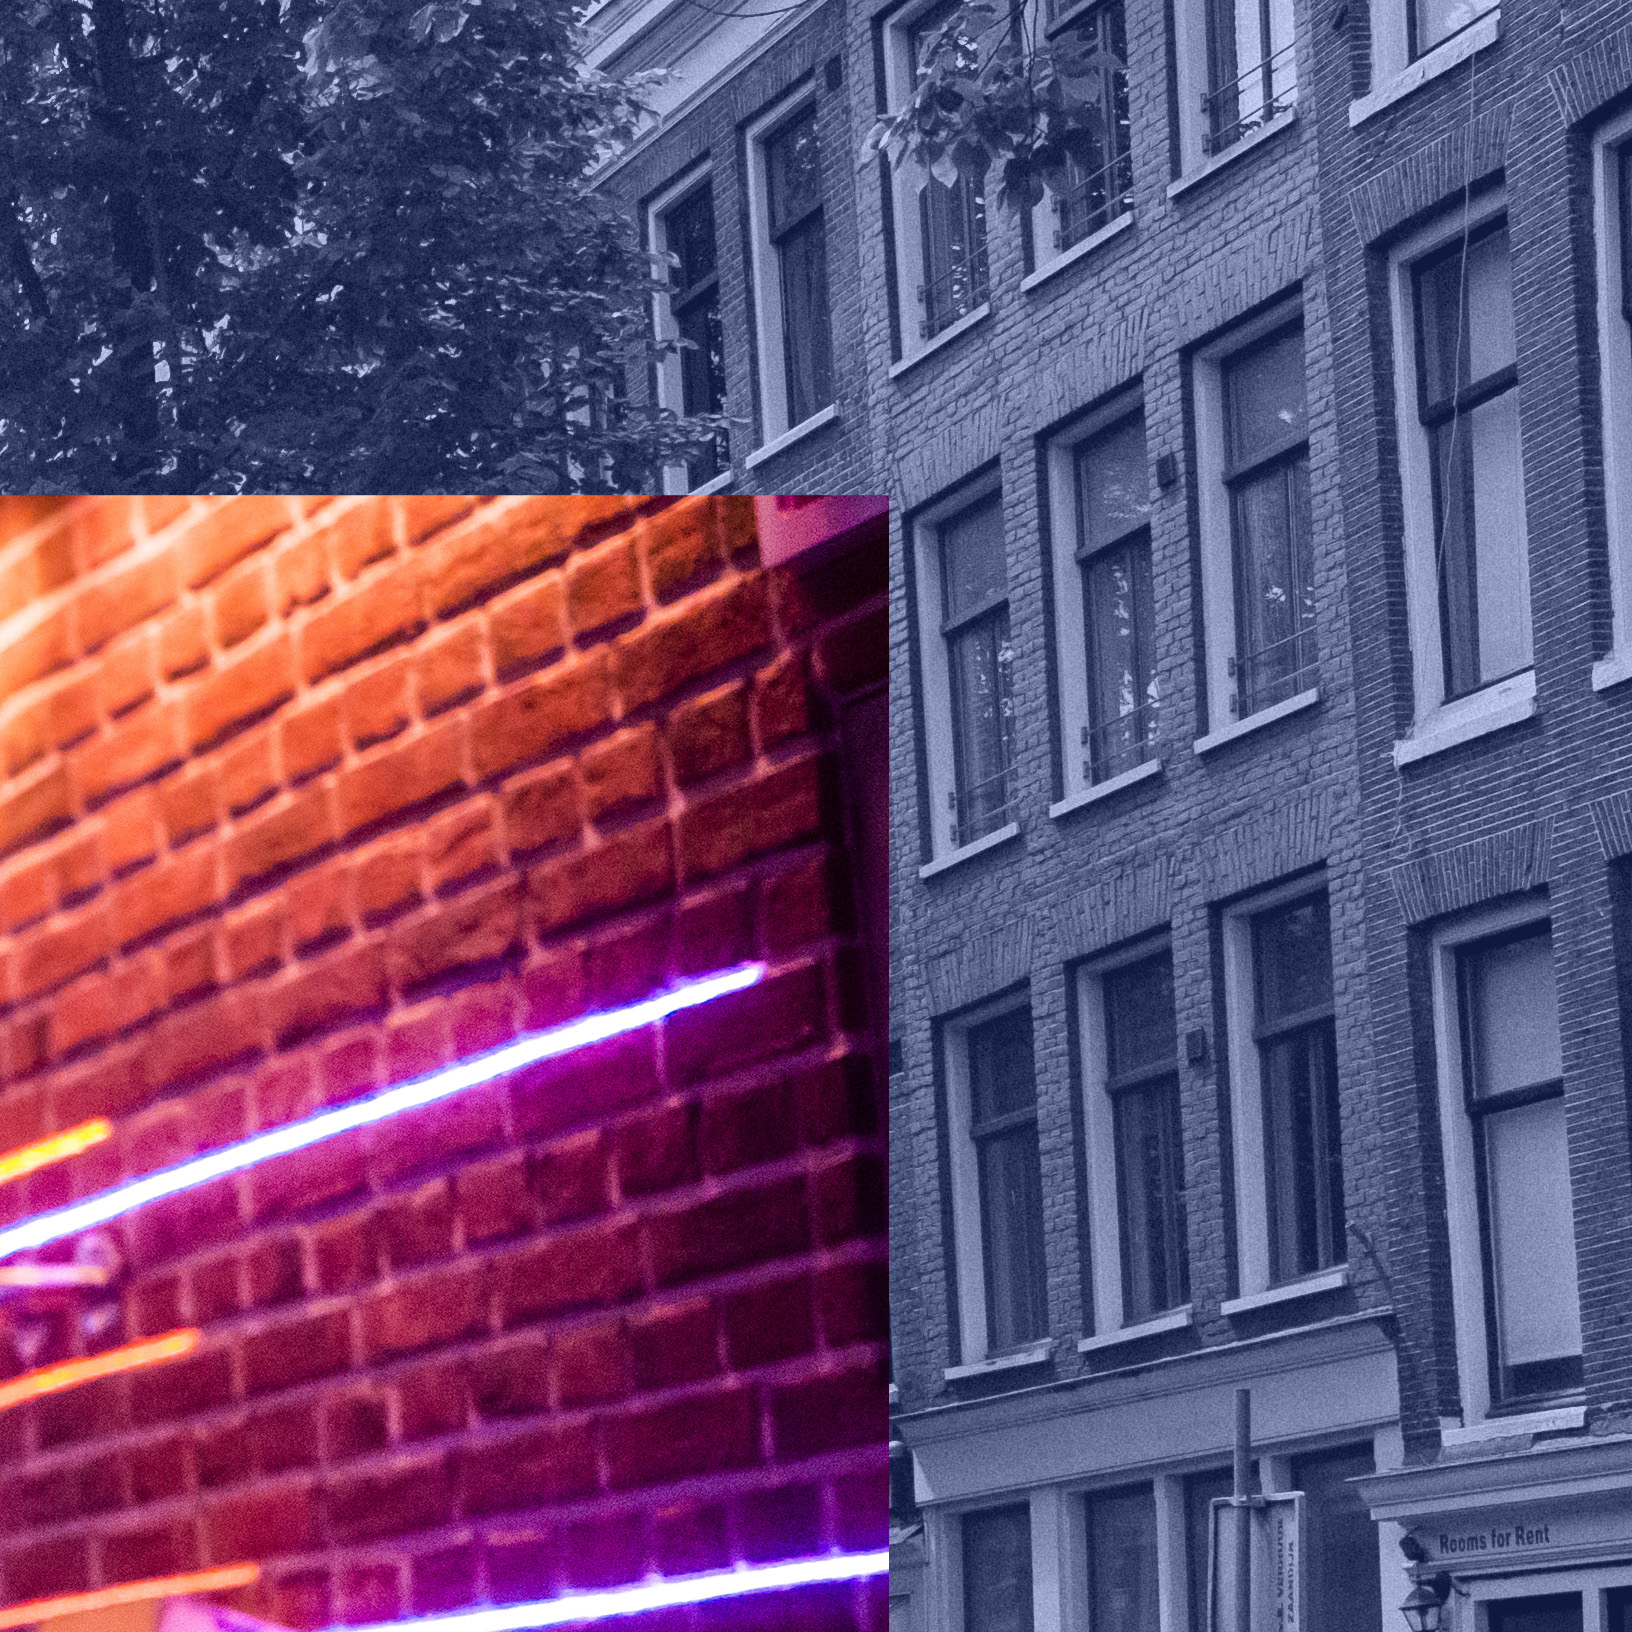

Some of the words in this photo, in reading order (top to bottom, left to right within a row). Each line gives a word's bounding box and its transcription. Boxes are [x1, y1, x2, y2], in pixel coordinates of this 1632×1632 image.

[1438, 1533, 1487, 1554] Rooms
[1490, 1529, 1512, 1548] for
[1514, 1524, 1550, 1547] Rent
